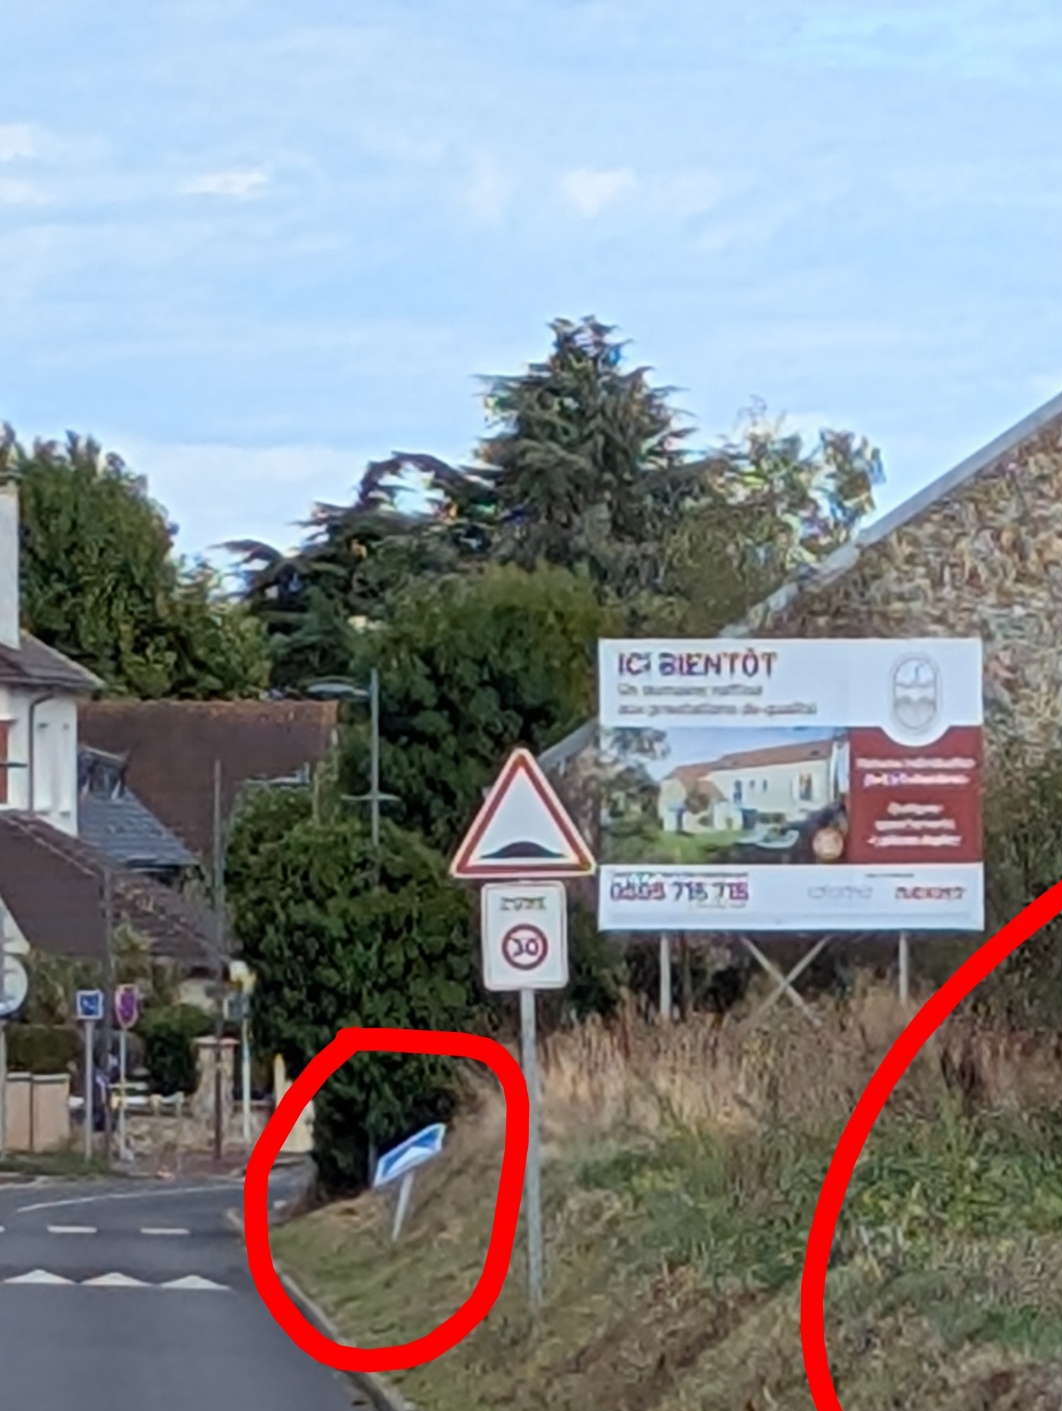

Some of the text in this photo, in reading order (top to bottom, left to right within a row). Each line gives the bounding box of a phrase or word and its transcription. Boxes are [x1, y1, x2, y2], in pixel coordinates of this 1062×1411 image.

[618, 647, 777, 678] ICI BIENTÔT
[511, 938, 540, 957] 30
